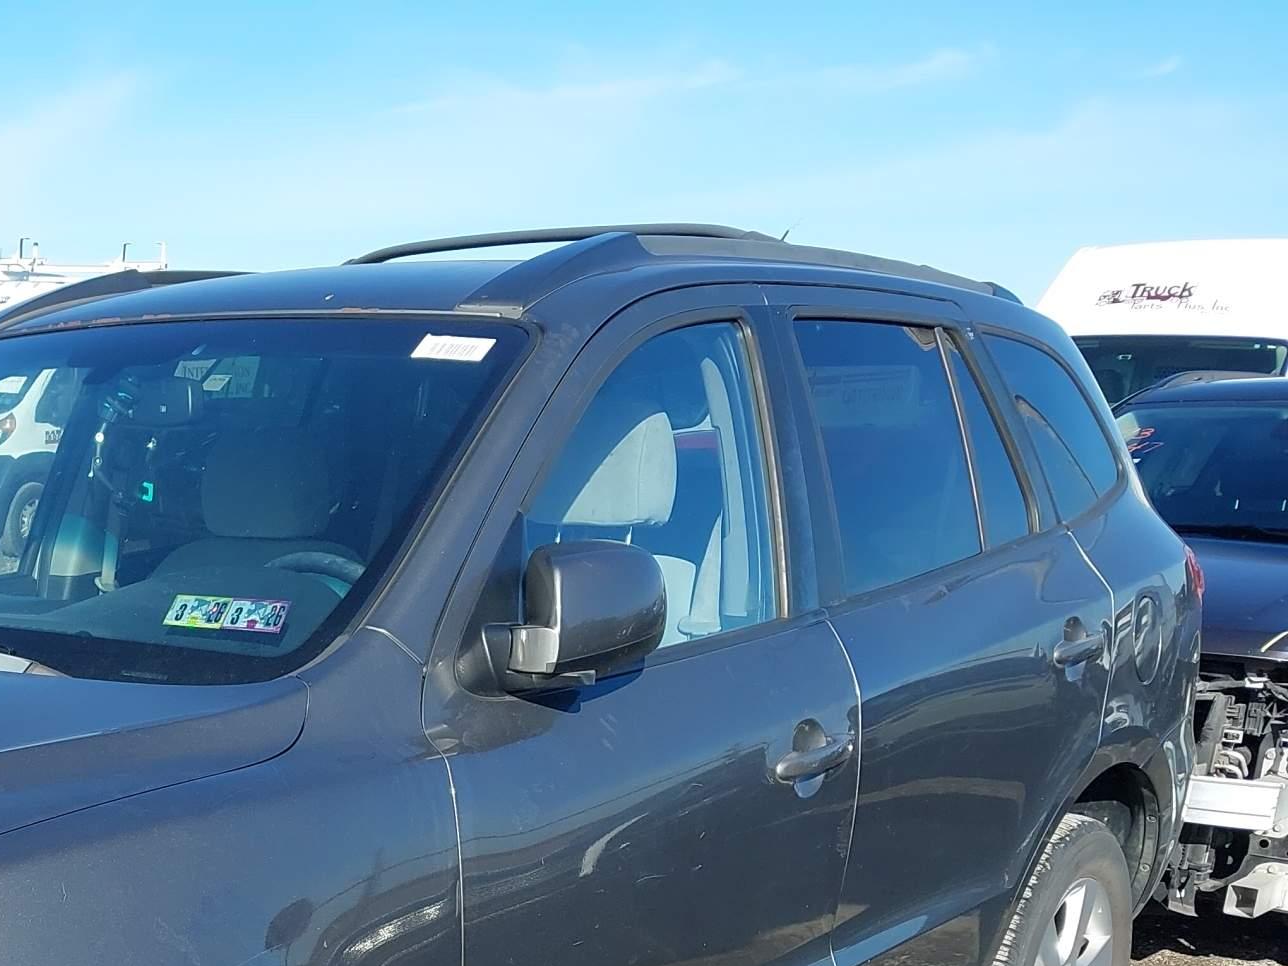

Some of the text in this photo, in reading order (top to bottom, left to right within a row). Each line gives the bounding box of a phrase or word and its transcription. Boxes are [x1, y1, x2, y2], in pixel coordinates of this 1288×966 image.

[174, 601, 228, 623] 3 26
[230, 604, 286, 627] 3 26
